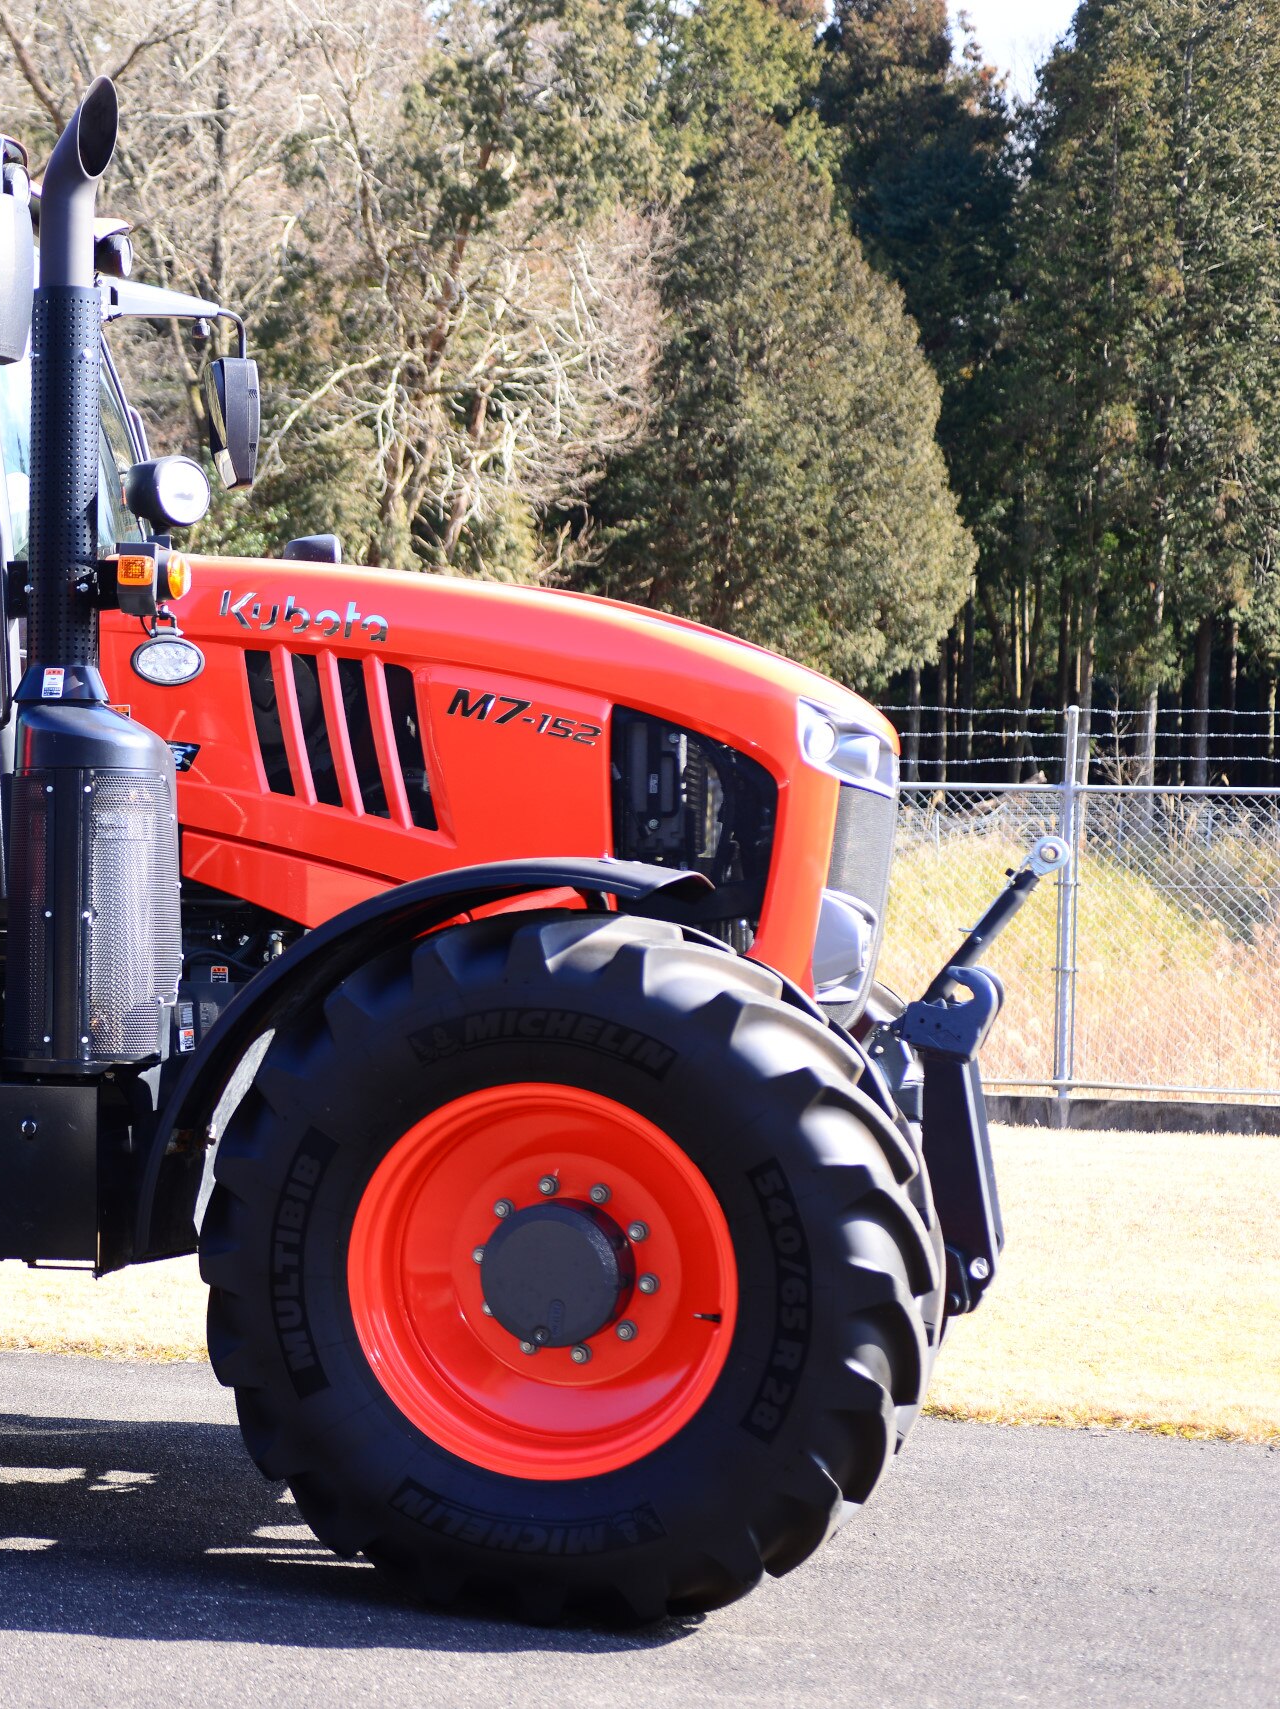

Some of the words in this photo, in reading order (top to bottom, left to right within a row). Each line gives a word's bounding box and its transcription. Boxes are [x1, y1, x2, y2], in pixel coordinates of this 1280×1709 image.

[220, 589, 389, 643] Kubota
[446, 688, 603, 746] M7-152
[464, 1010, 672, 1072] MICHELIN
[274, 1153, 321, 1372] MULTIBIB
[755, 1169, 807, 1330] 540/65
[773, 1338, 803, 1372] R
[751, 1376, 792, 1432] 28
[396, 1488, 606, 1555] MICHELIN
